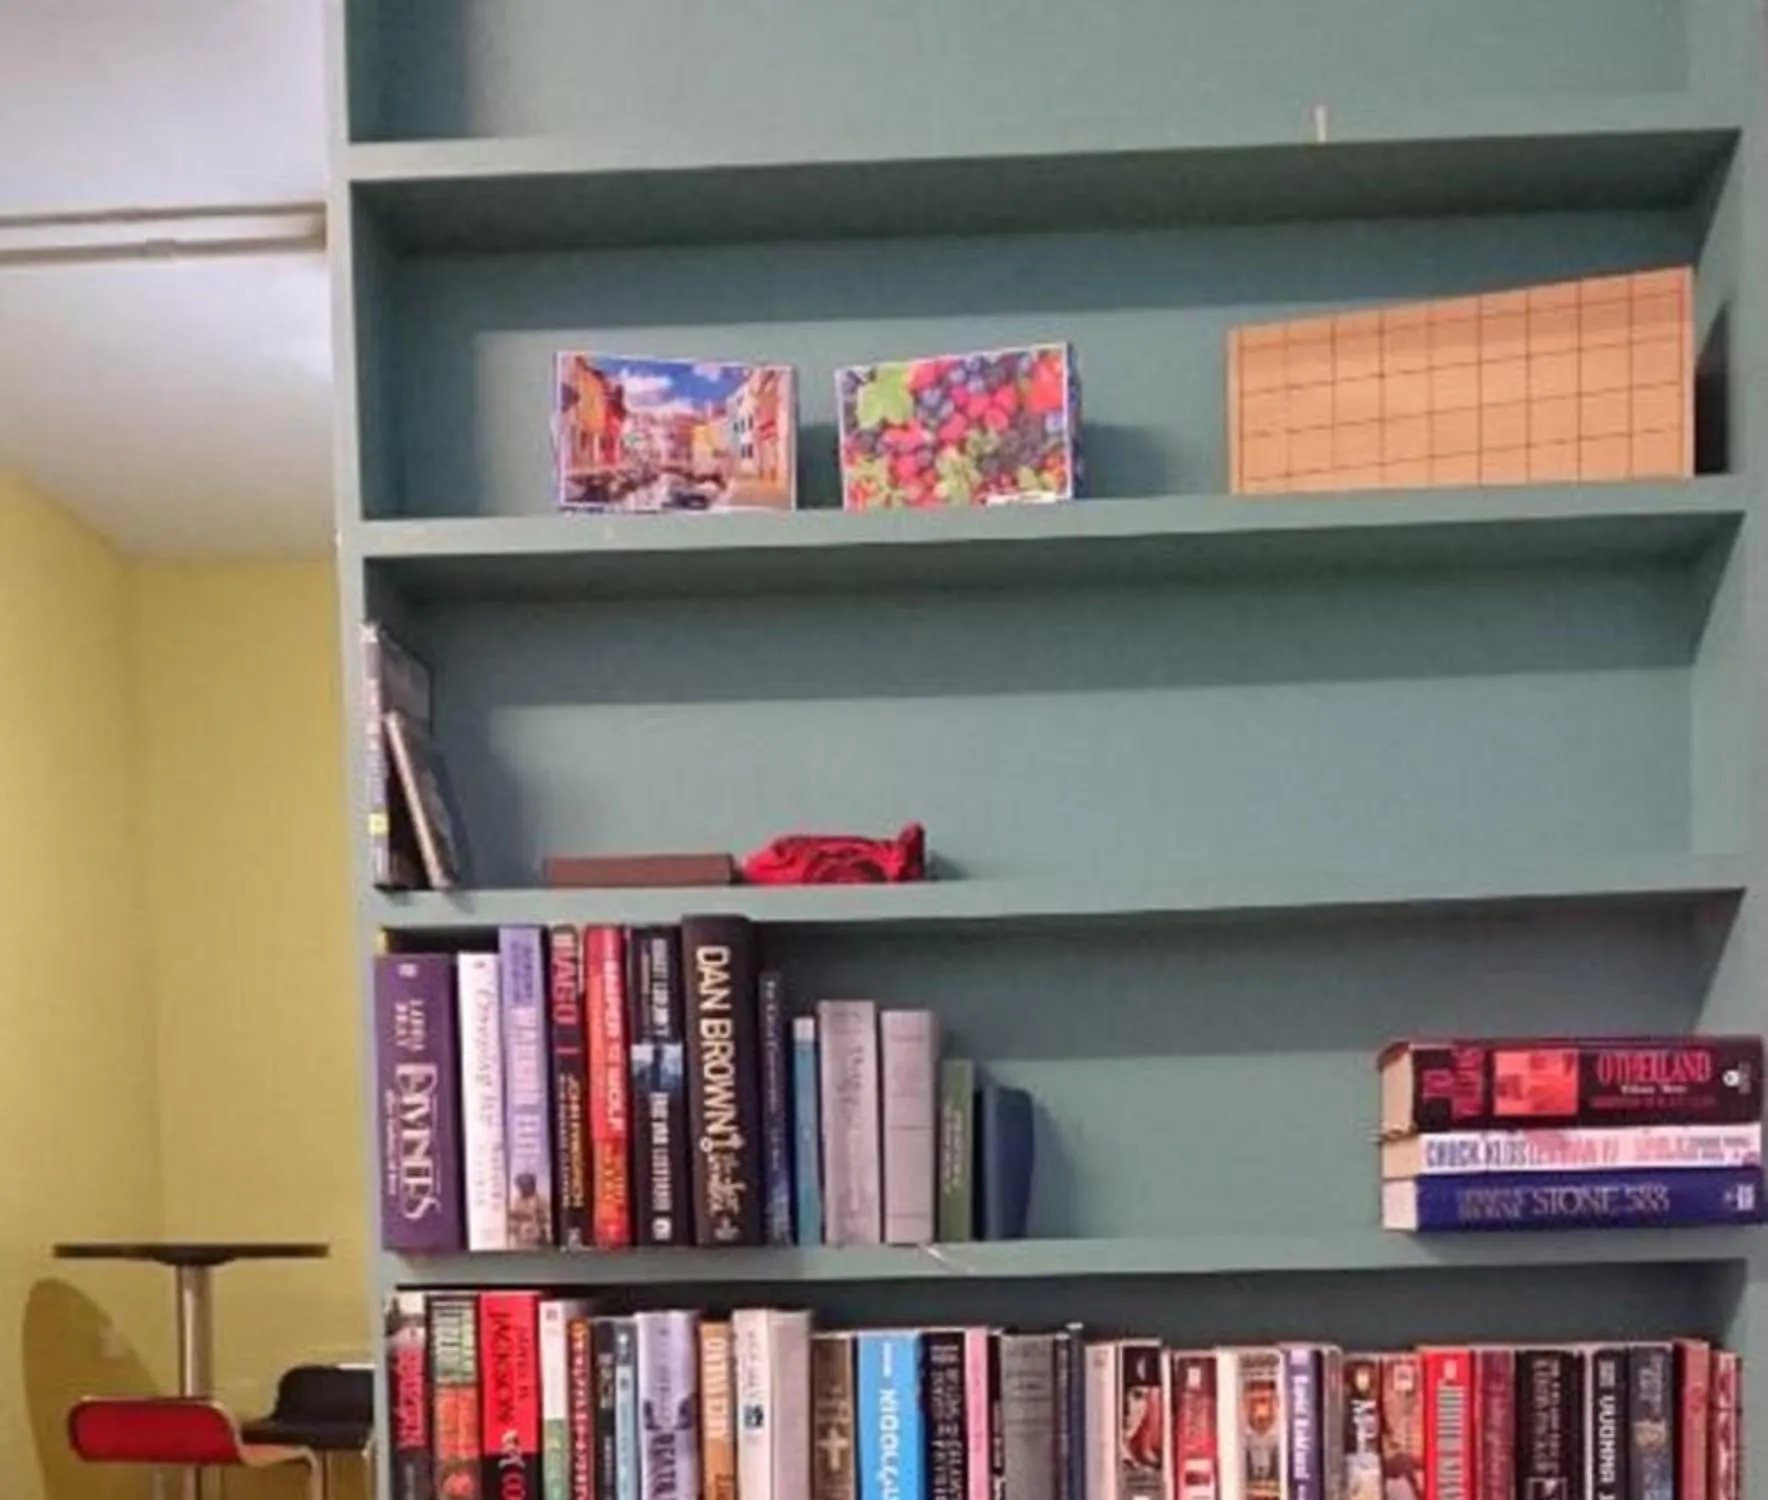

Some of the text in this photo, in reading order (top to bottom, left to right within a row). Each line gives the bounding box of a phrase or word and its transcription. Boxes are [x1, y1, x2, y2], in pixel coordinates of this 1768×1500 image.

[696, 946, 731, 1010] DAN
[700, 1018, 737, 1133] BROWN
[1426, 1138, 1481, 1168] CHUCK
[490, 1312, 515, 1424] JACKSON
